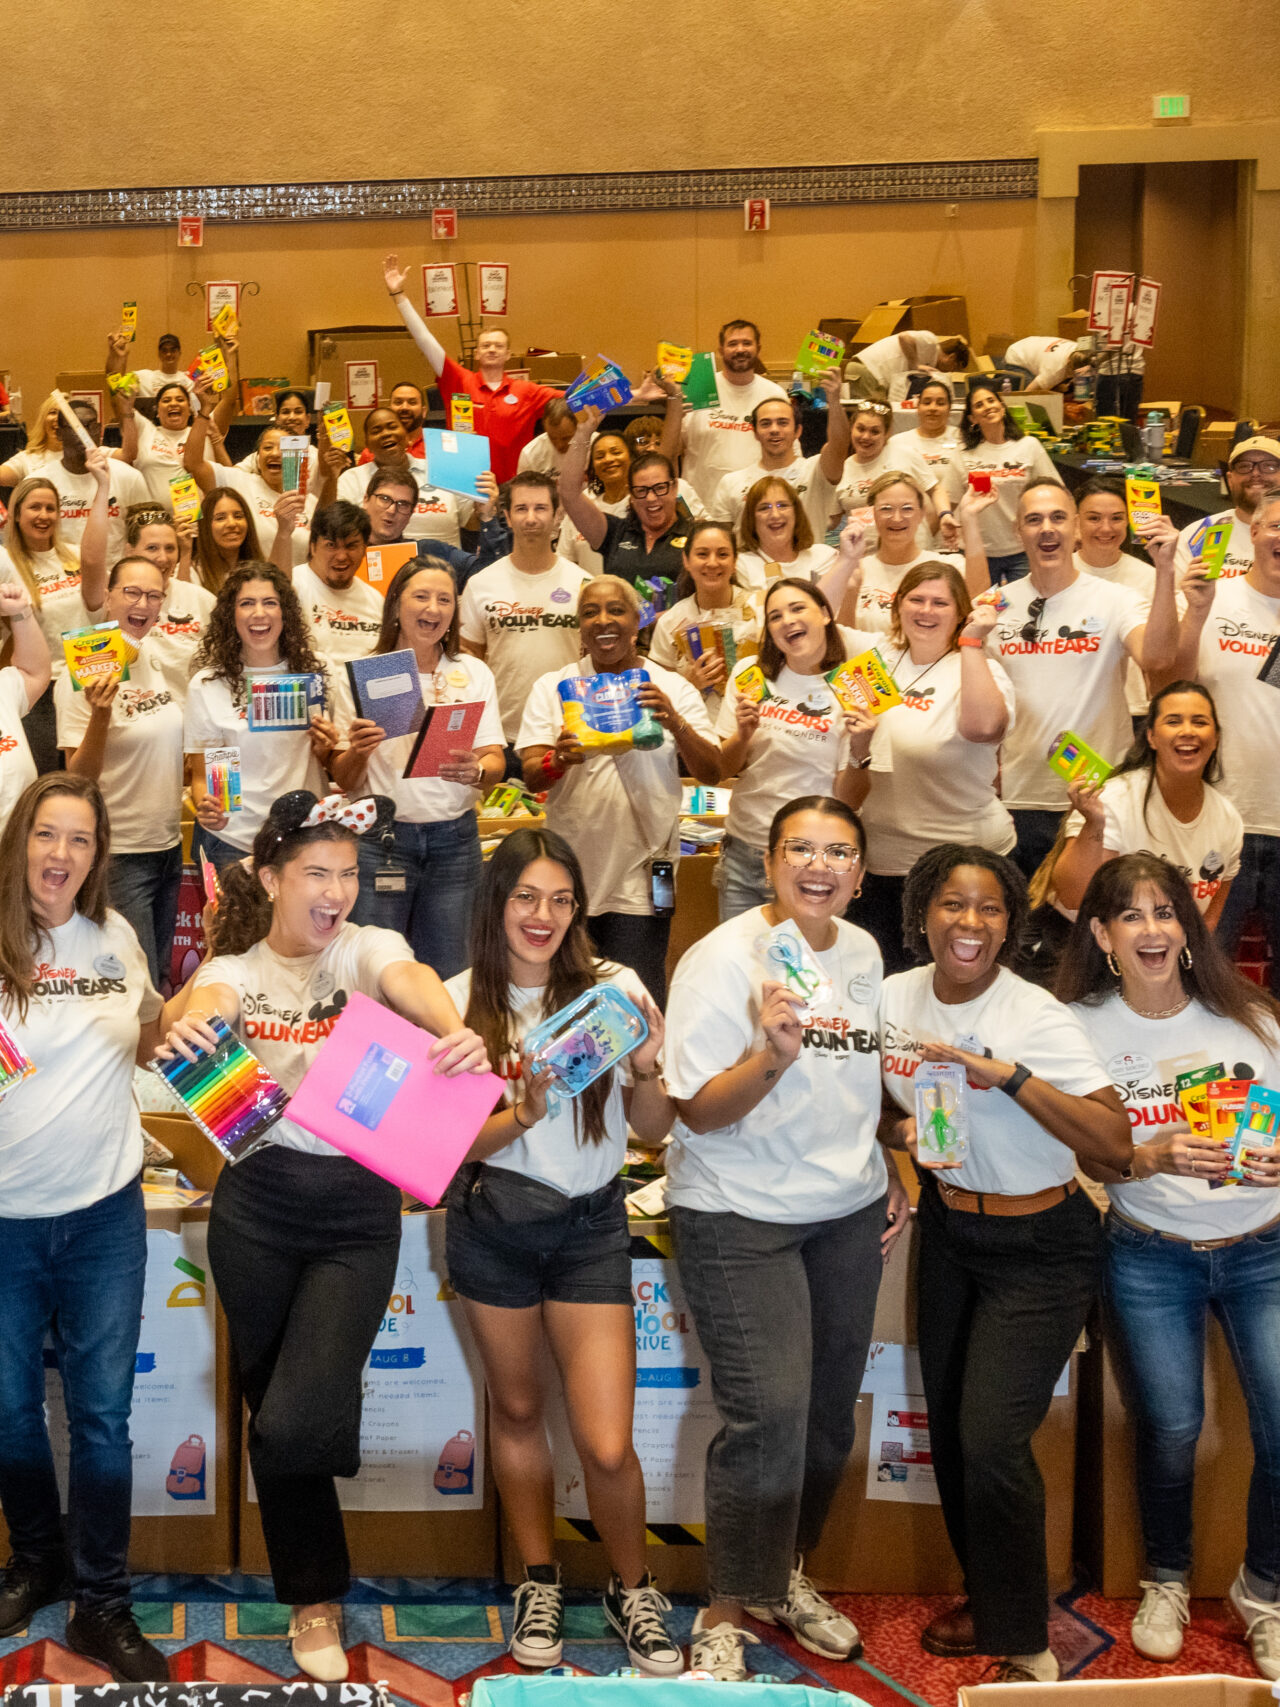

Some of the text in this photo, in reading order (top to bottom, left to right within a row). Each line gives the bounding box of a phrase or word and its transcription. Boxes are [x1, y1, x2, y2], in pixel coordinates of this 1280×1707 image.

[1160, 97, 1184, 116] EXIT
[708, 421, 754, 433] VOLUNTEA
[1224, 553, 1254, 574] isney
[997, 628, 1048, 645] Diey
[999, 637, 1101, 657] VOLUNTEARS
[1218, 638, 1274, 658] VOLUN
[74, 660, 122, 679] MARKERS
[867, 661, 894, 694] Crayola
[838, 670, 870, 710] MARKER
[33, 976, 127, 997] OLUNTEARS
[1180, 1078, 1193, 1090] 12
[637, 1281, 670, 1303] CK
[641, 1303, 658, 1314] TO
[635, 1309, 690, 1335] HOOL
[636, 1335, 671, 1351] RIVE
[637, 1373, 672, 1382] 3-AUG
